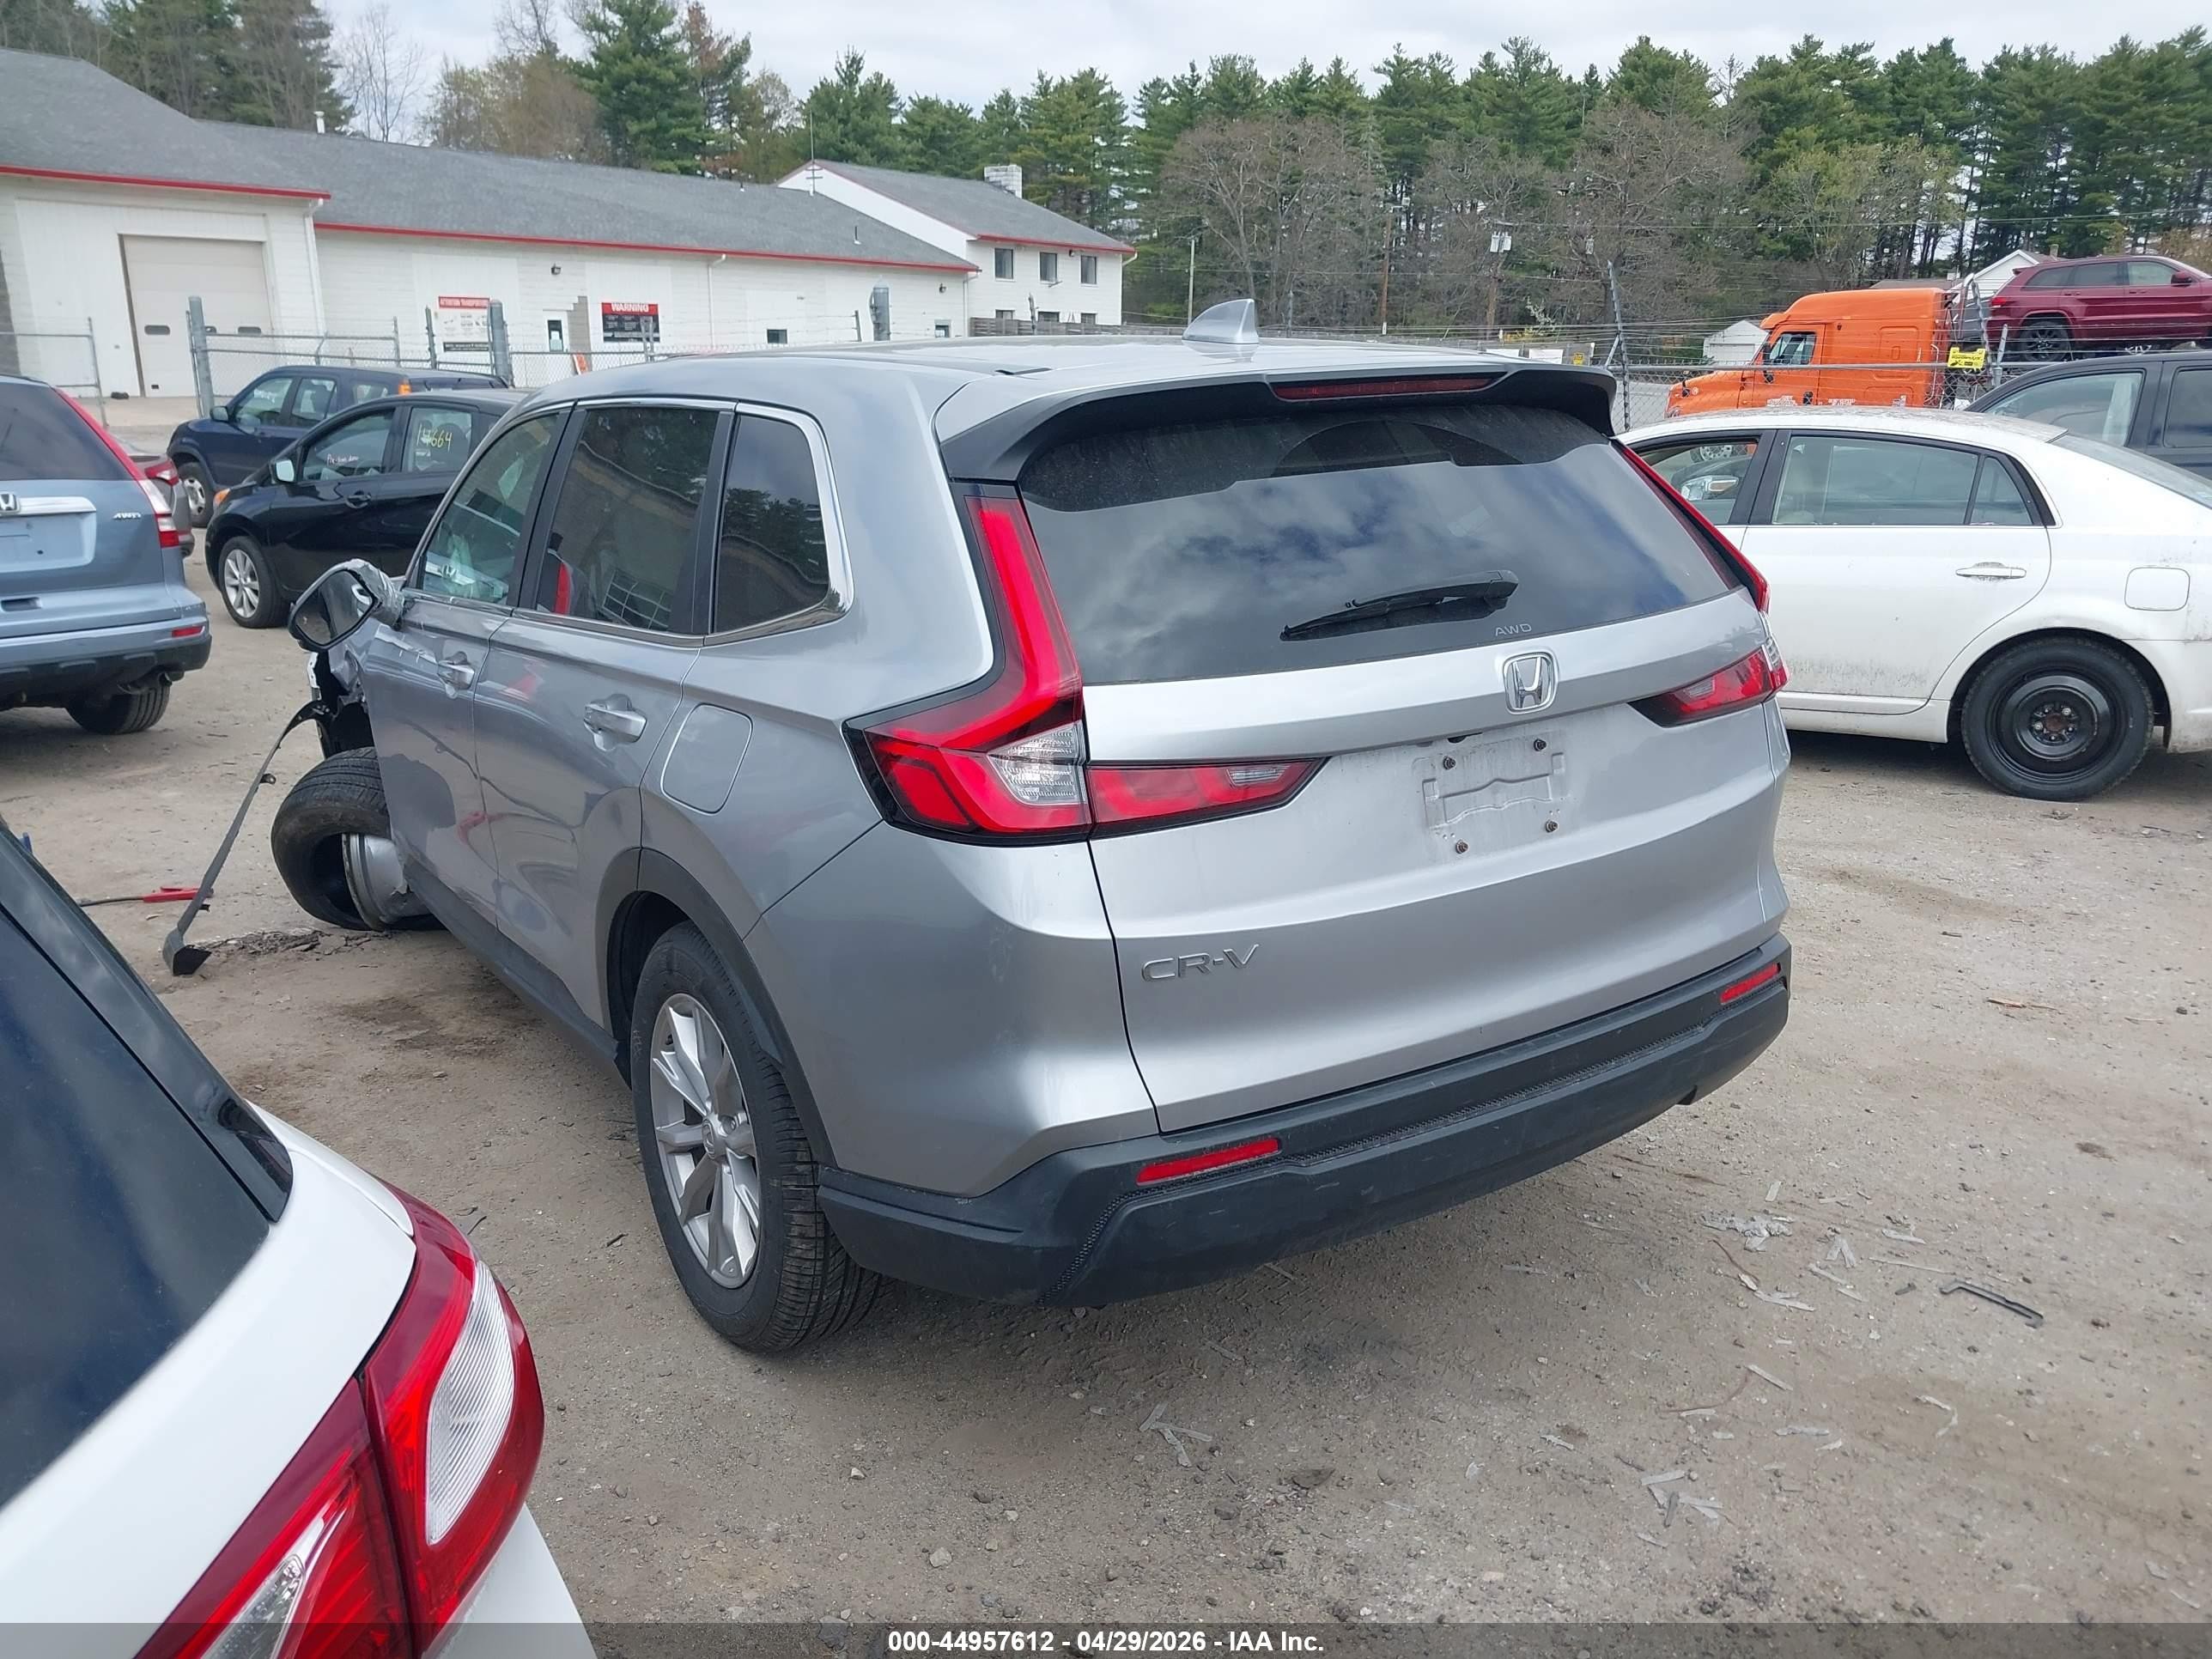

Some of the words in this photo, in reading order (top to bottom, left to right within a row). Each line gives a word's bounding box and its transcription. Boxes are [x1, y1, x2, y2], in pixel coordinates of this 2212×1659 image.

[611, 302, 649, 313] WARNING
[1495, 623, 1532, 636] AWD
[1141, 943, 1261, 981] CR-V
